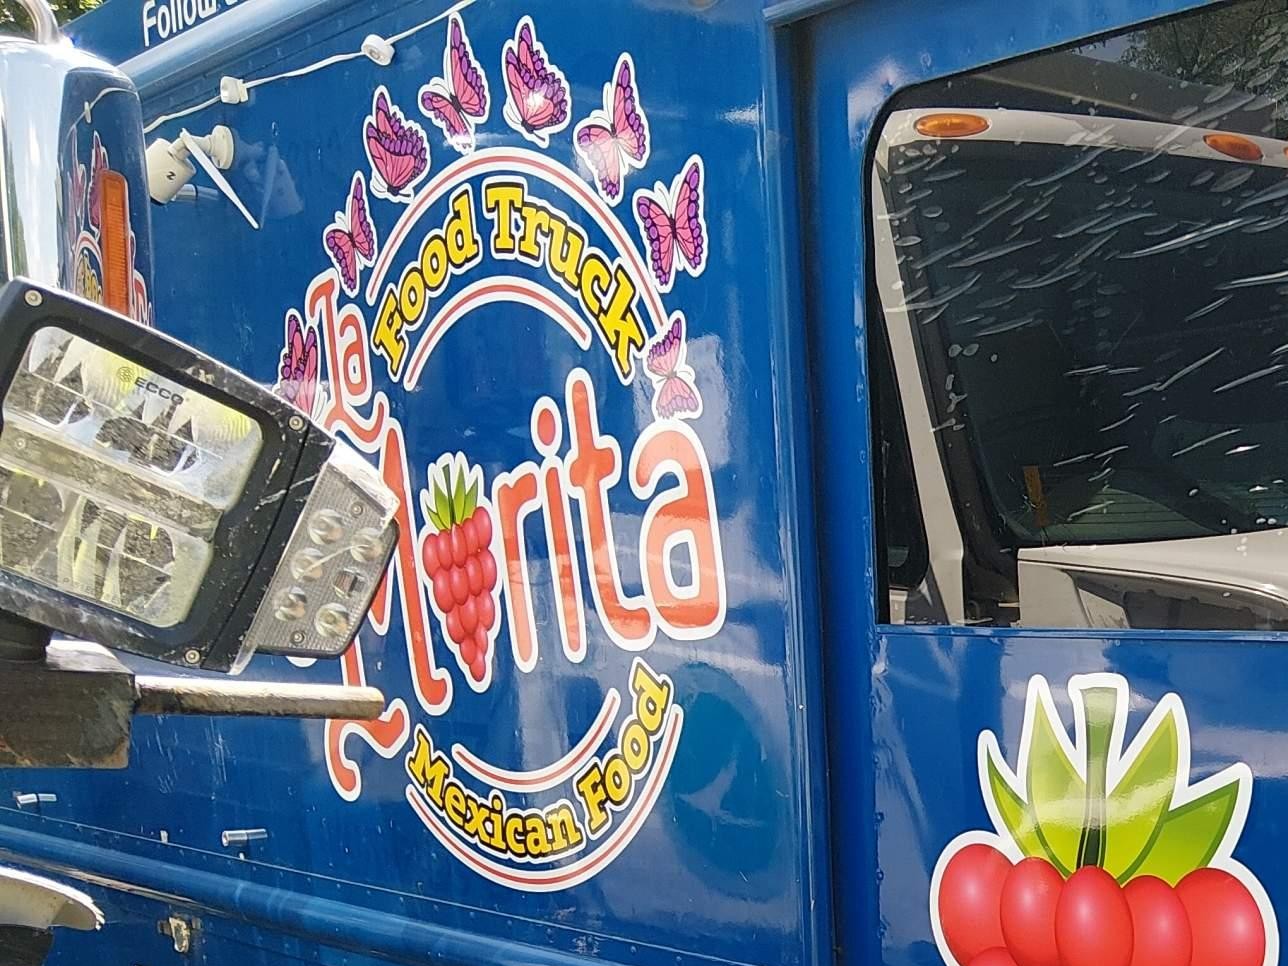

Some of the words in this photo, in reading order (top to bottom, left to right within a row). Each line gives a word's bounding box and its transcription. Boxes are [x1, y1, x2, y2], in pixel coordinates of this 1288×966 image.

[372, 188, 479, 376] Food
[484, 181, 647, 379] Truck
[134, 375, 184, 405] ECCO
[408, 728, 582, 857] Mexican
[576, 659, 671, 835] Food
